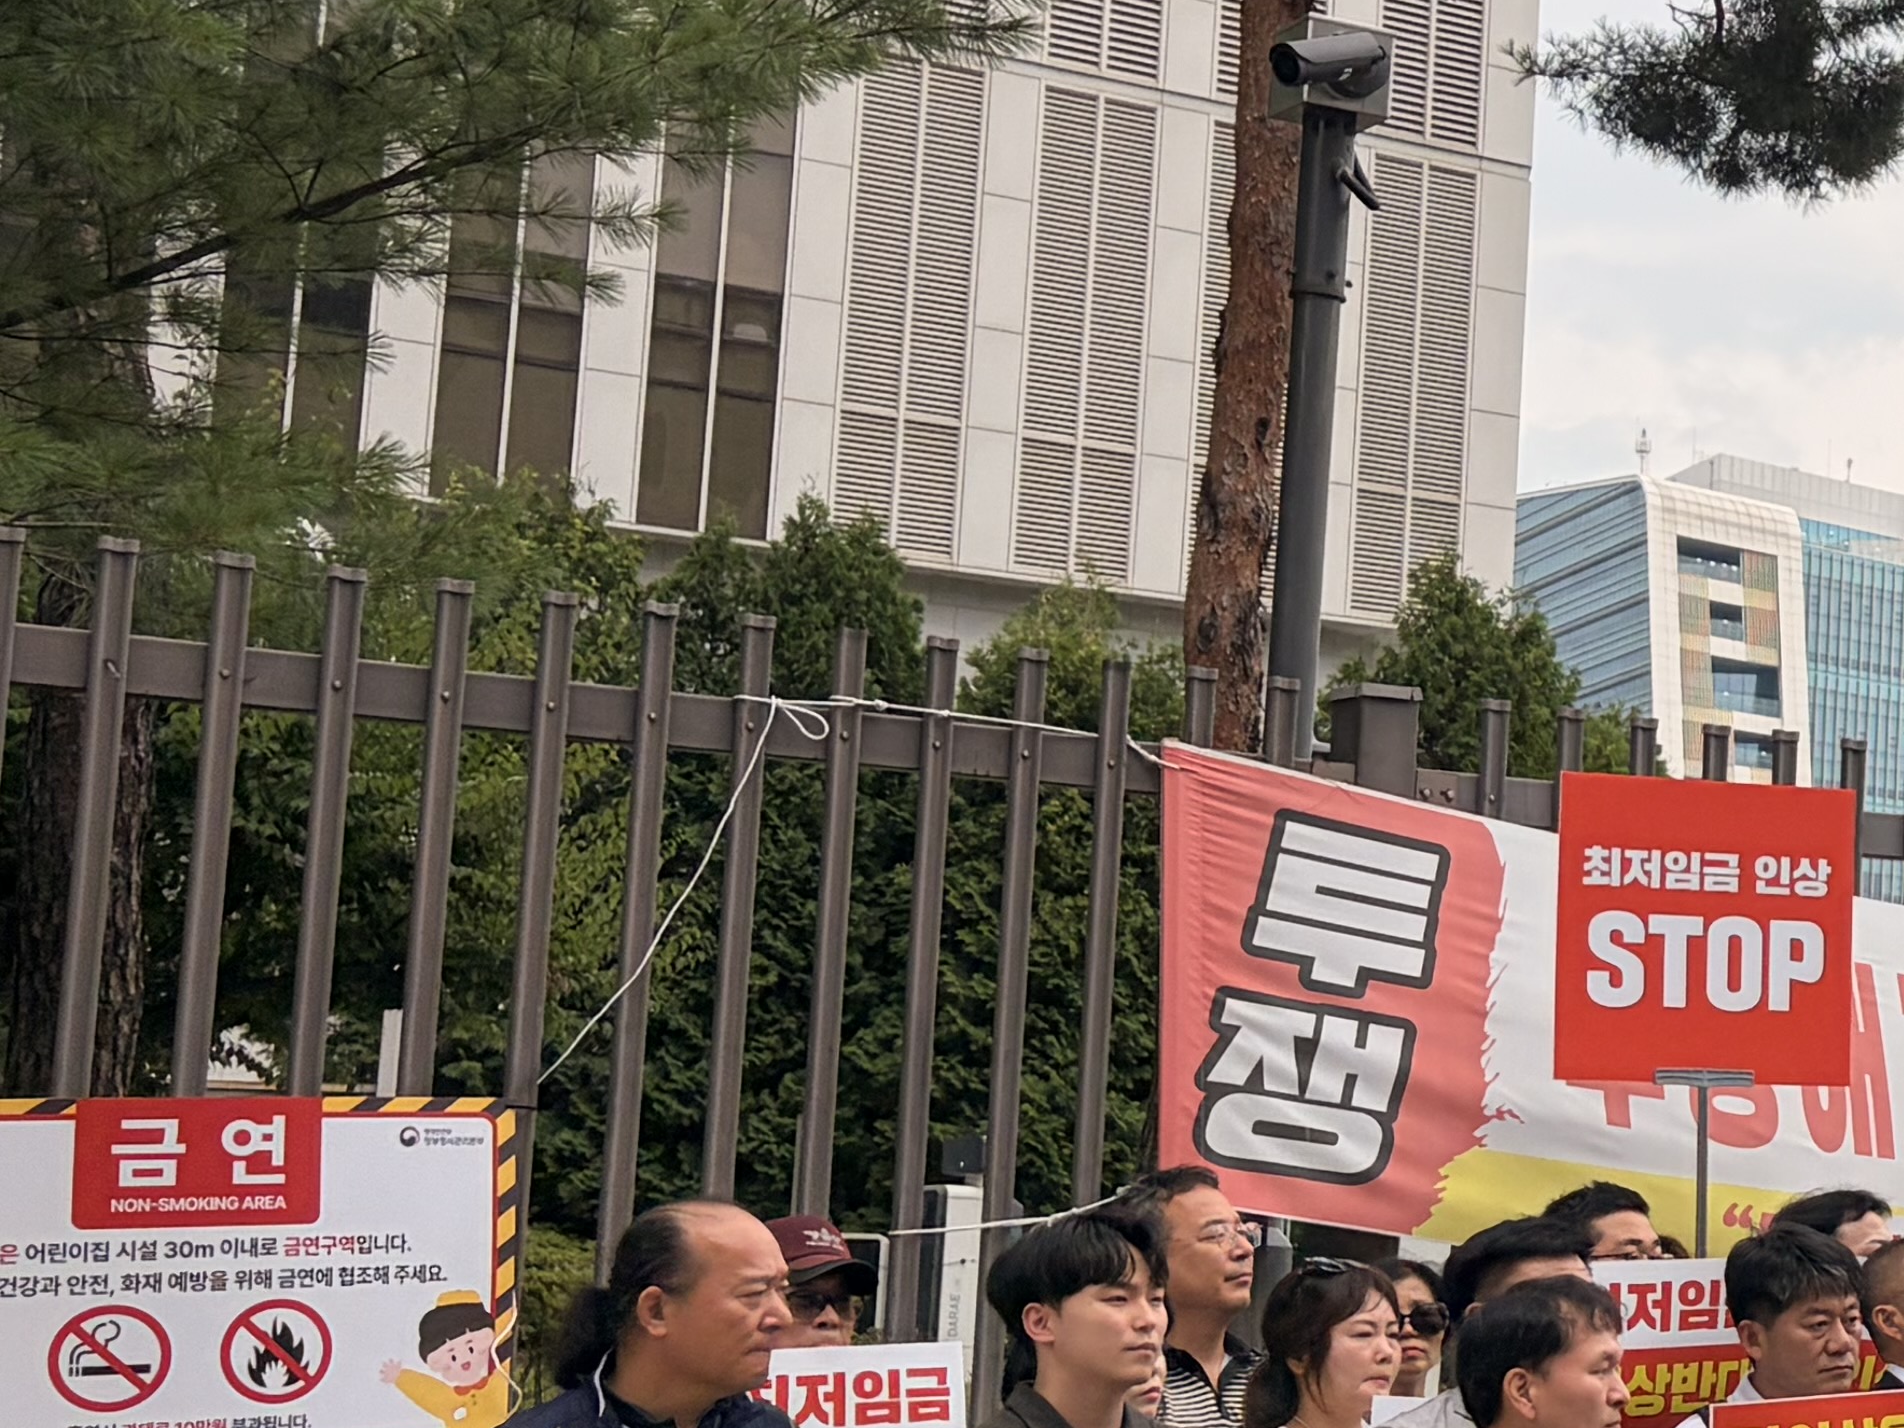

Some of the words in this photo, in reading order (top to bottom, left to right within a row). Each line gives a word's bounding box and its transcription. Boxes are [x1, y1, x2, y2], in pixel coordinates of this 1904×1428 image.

[1582, 845, 1741, 893] 최저임금
[1754, 854, 1832, 898] 인상
[1586, 910, 1825, 1013] STOP
[1194, 808, 1450, 1185] 투쟁
[110, 1196, 239, 1213] NON-SMOKING
[242, 1195, 287, 1210] AREA
[25, 1241, 110, 1264] 어린이집
[115, 1240, 158, 1262] 시설
[163, 1240, 214, 1259] 30m
[220, 1237, 279, 1259] 이내로
[283, 1233, 412, 1257] 금연구역입니다.
[0, 1275, 62, 1298] 건강과
[67, 1274, 115, 1298] 안전,
[120, 1272, 163, 1294] 화재
[168, 1270, 229, 1292] 예방을
[234, 1269, 273, 1290] 위해
[277, 1267, 333, 1289] 금연에
[338, 1265, 390, 1287] 협조해
[394, 1264, 448, 1286] 주세요.
